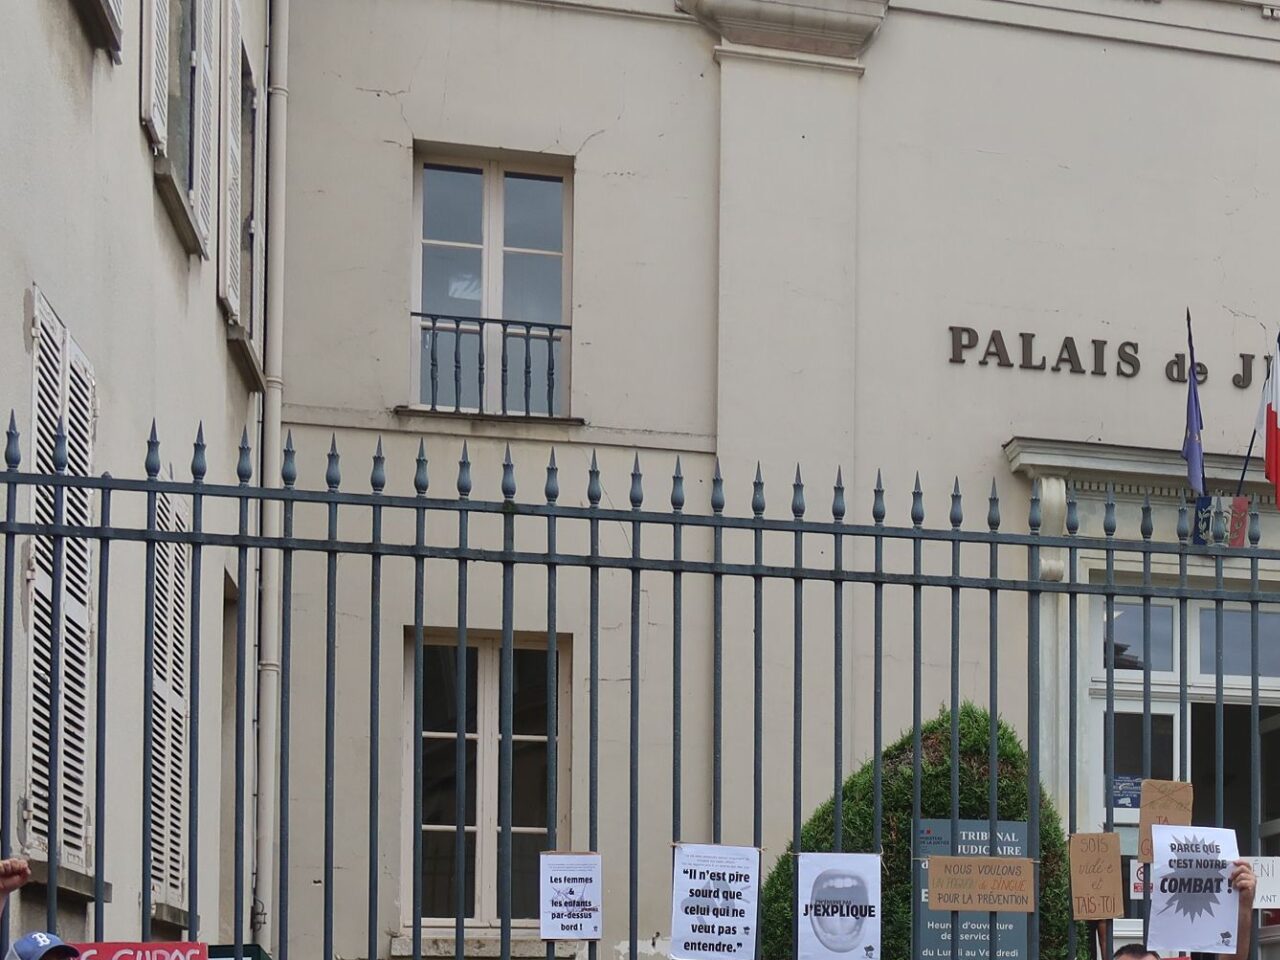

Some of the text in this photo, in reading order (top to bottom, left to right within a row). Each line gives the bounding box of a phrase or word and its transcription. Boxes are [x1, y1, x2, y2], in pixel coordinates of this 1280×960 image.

[948, 325, 1141, 379] PALAIS
[1165, 353, 1209, 384] de
[960, 831, 1019, 842] TRIBNAL
[1170, 843, 1221, 853] PARCE QUE
[944, 864, 1021, 876] NOUS VOULONS
[1168, 859, 1227, 869] C'EST NOTRE
[729, 871, 750, 883] pire
[1160, 878, 1224, 893] COMBAT
[689, 888, 742, 902] sourd que
[938, 893, 959, 904] POUR
[962, 894, 972, 904] LA
[551, 912, 592, 920] par-dessus
[684, 905, 745, 918] celui qui ne
[803, 903, 876, 920] J'EXPLIQUE
[691, 923, 737, 936] veut pas
